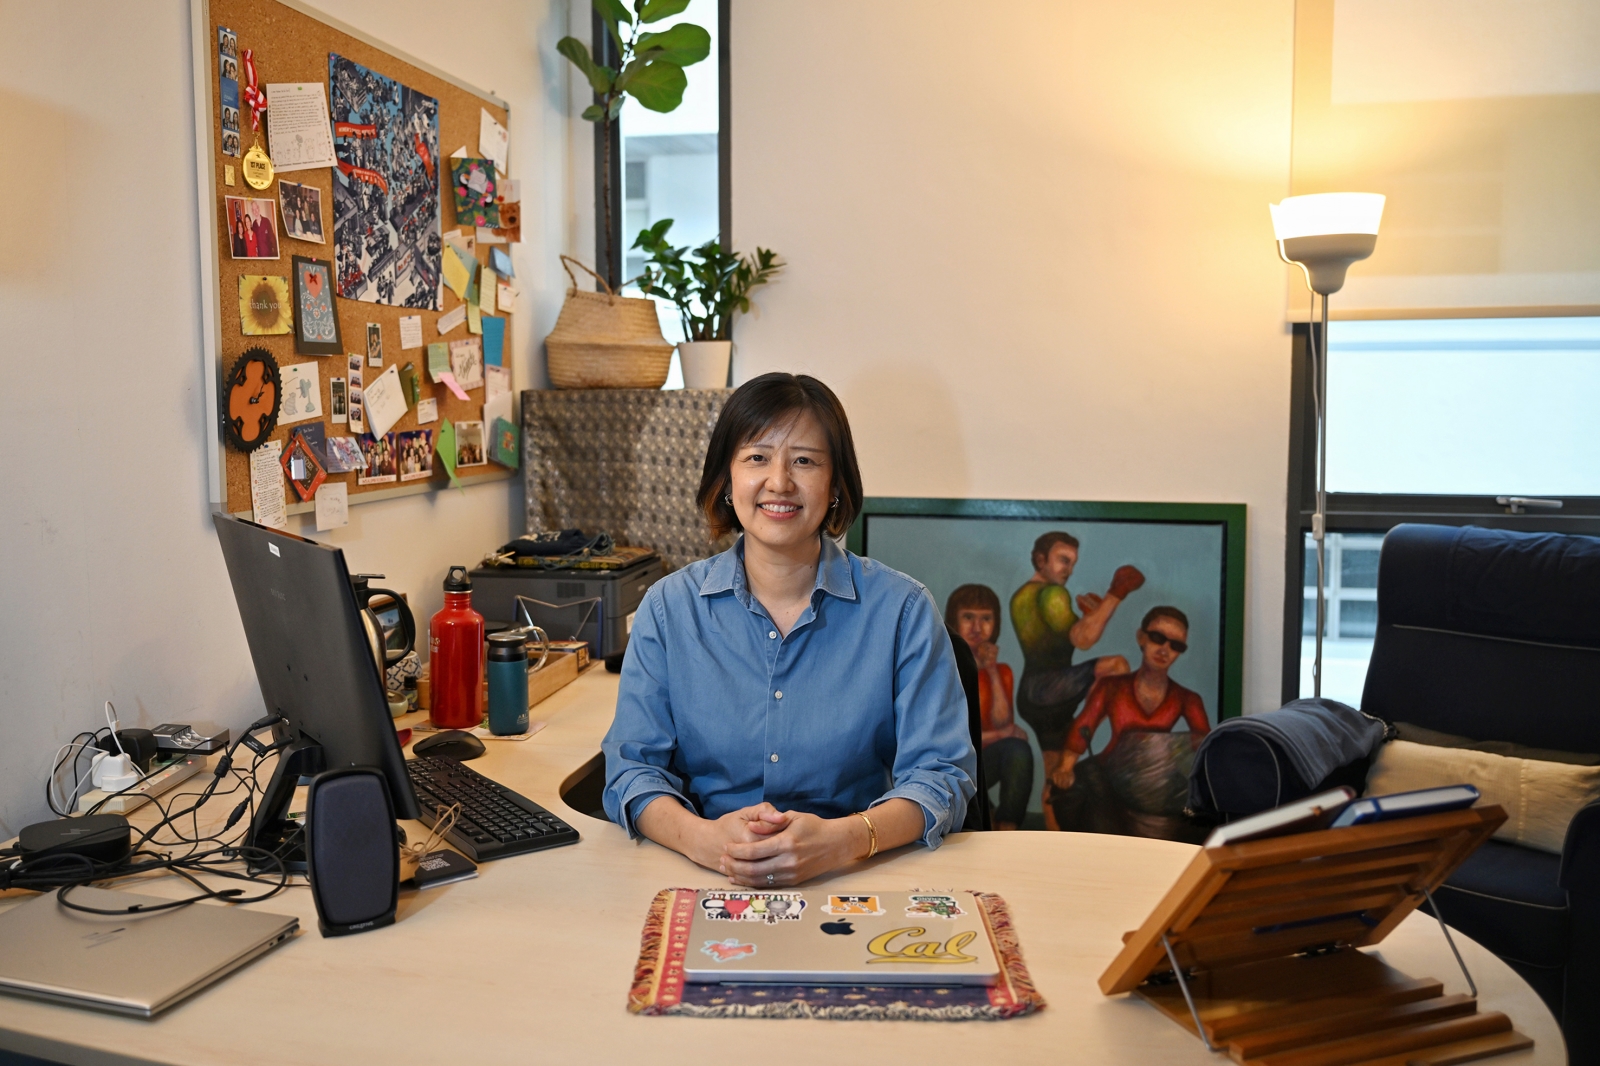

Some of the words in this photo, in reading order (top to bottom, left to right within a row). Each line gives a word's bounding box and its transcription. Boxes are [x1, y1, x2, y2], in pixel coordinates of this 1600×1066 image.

[256, 162, 265, 170] PLACE
[249, 298, 268, 310] thank
[269, 302, 282, 312] you
[866, 926, 978, 965] Cal
